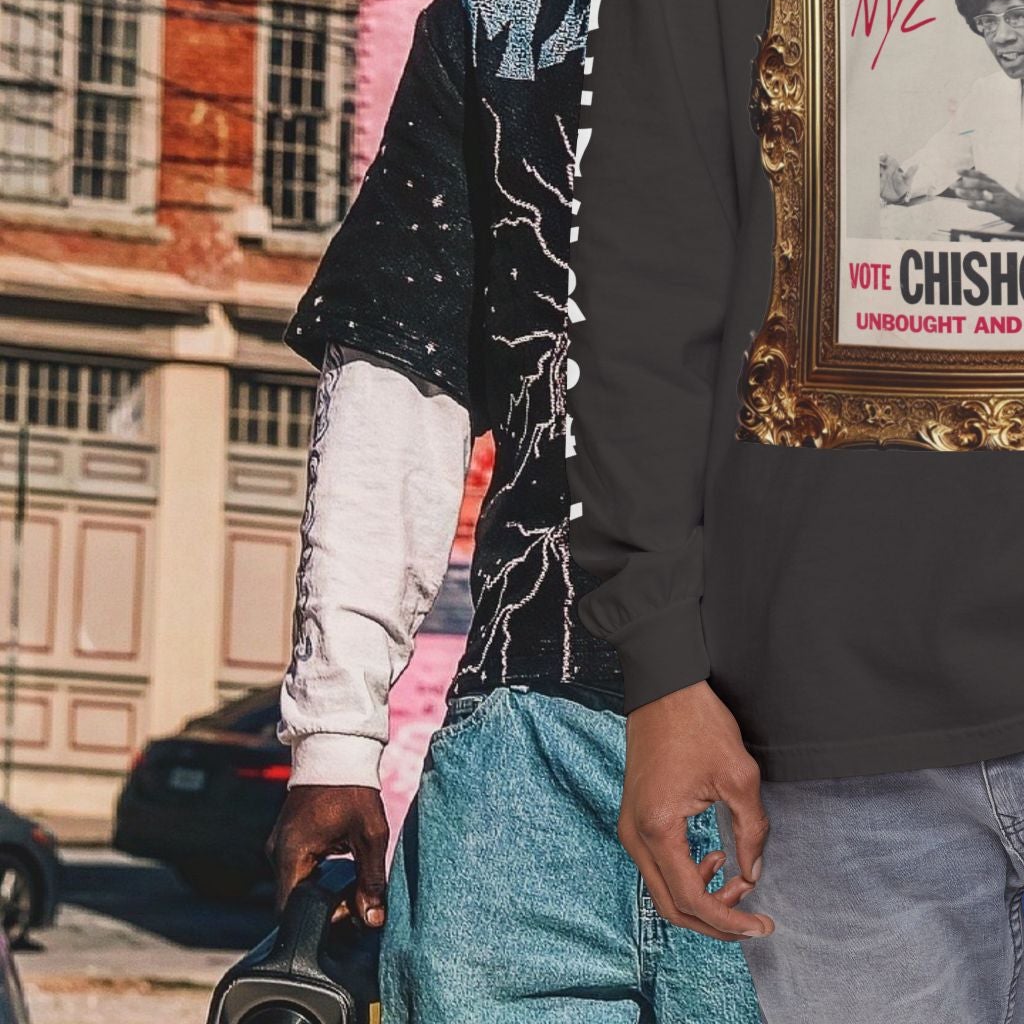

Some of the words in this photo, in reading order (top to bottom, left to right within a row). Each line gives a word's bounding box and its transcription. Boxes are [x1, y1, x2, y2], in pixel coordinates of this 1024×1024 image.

[849, 262, 892, 291] VOTE
[856, 313, 966, 334] UNBOUGHT
[974, 316, 1022, 334] AND
